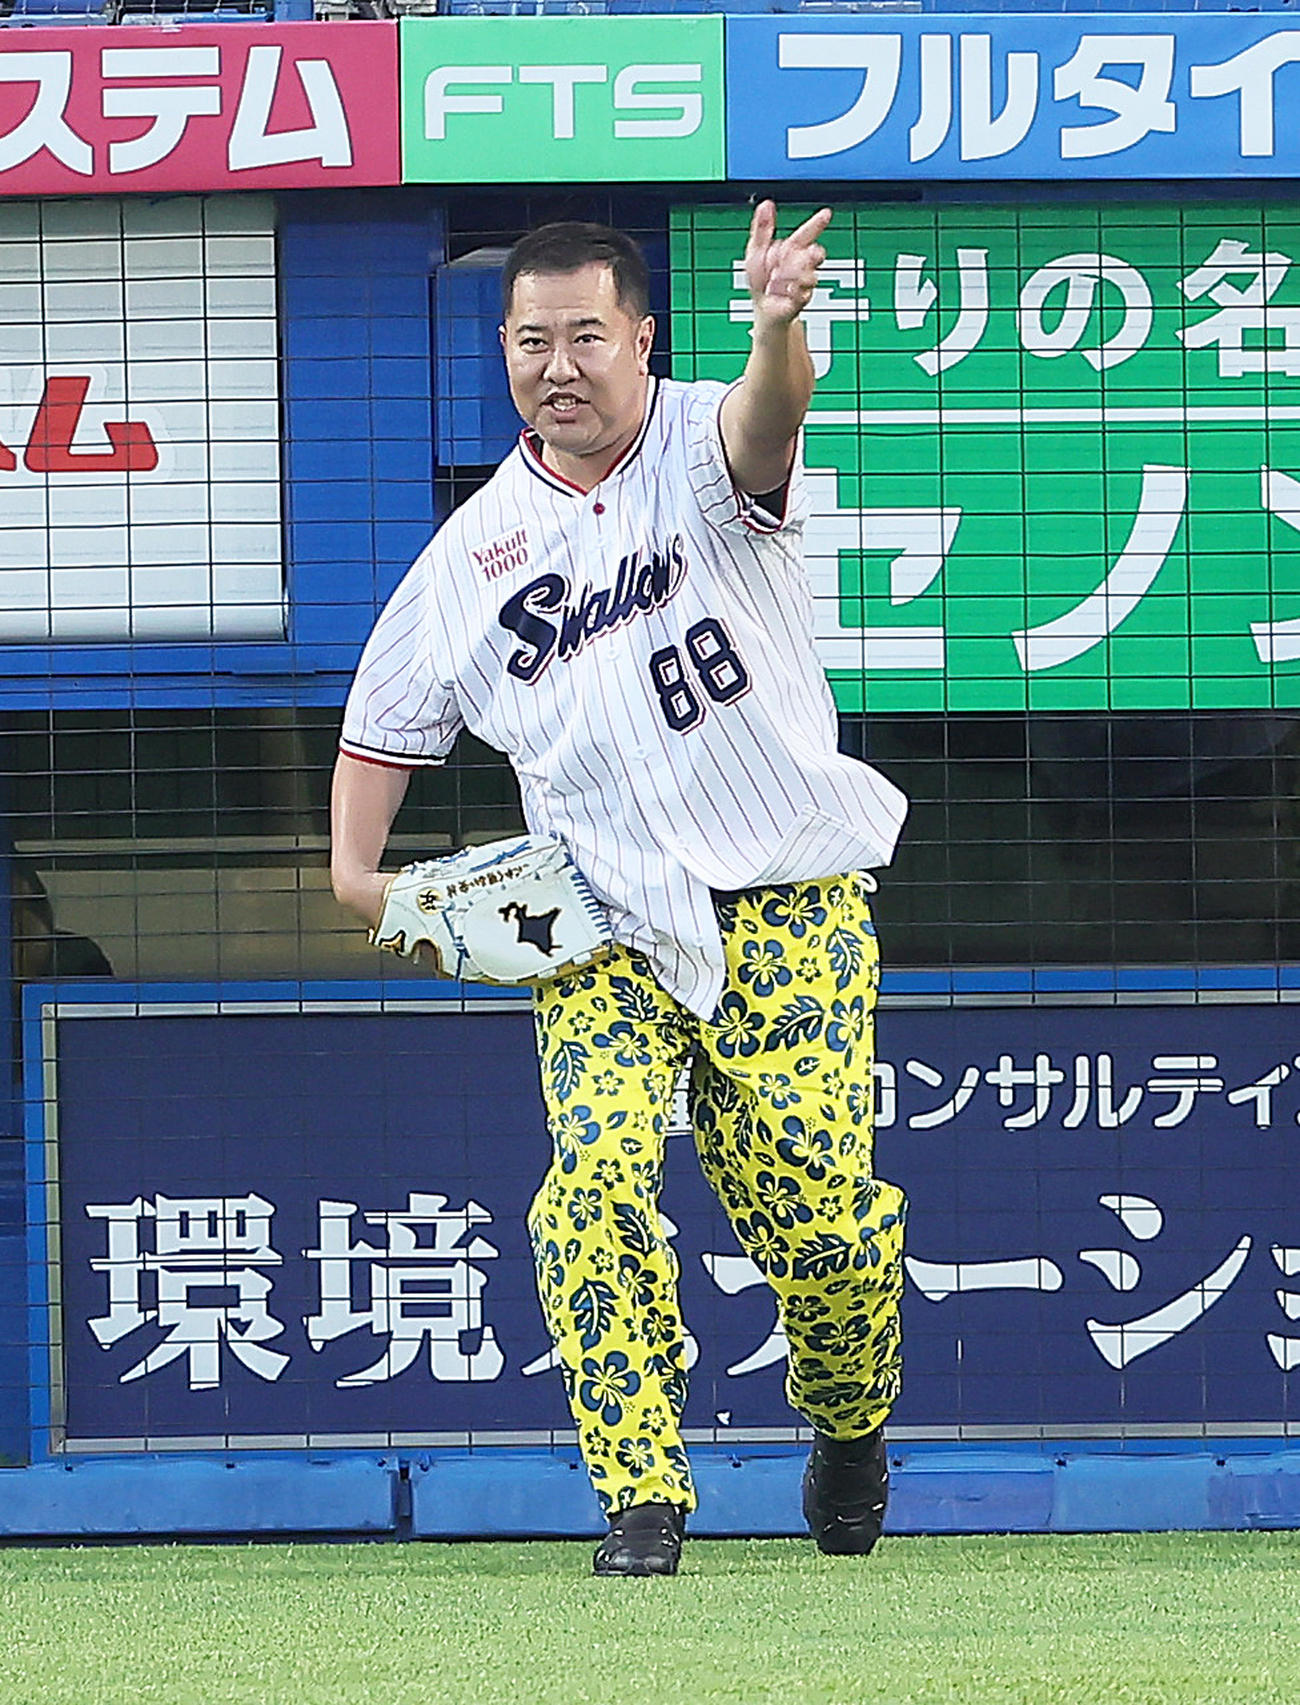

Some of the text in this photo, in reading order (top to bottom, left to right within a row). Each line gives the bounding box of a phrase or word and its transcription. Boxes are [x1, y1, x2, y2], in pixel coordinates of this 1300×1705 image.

[0, 46, 354, 176] ステム
[424, 64, 702, 140] FTS
[778, 31, 1300, 163] フルタイ
[0, 376, 159, 473] ム
[472, 528, 528, 567] Yakult
[481, 547, 528, 582] 1000
[803, 465, 1300, 673] セノ
[498, 532, 688, 686] Swallows
[649, 617, 752, 736] 88
[870, 1053, 1300, 1130] コンサルティ
